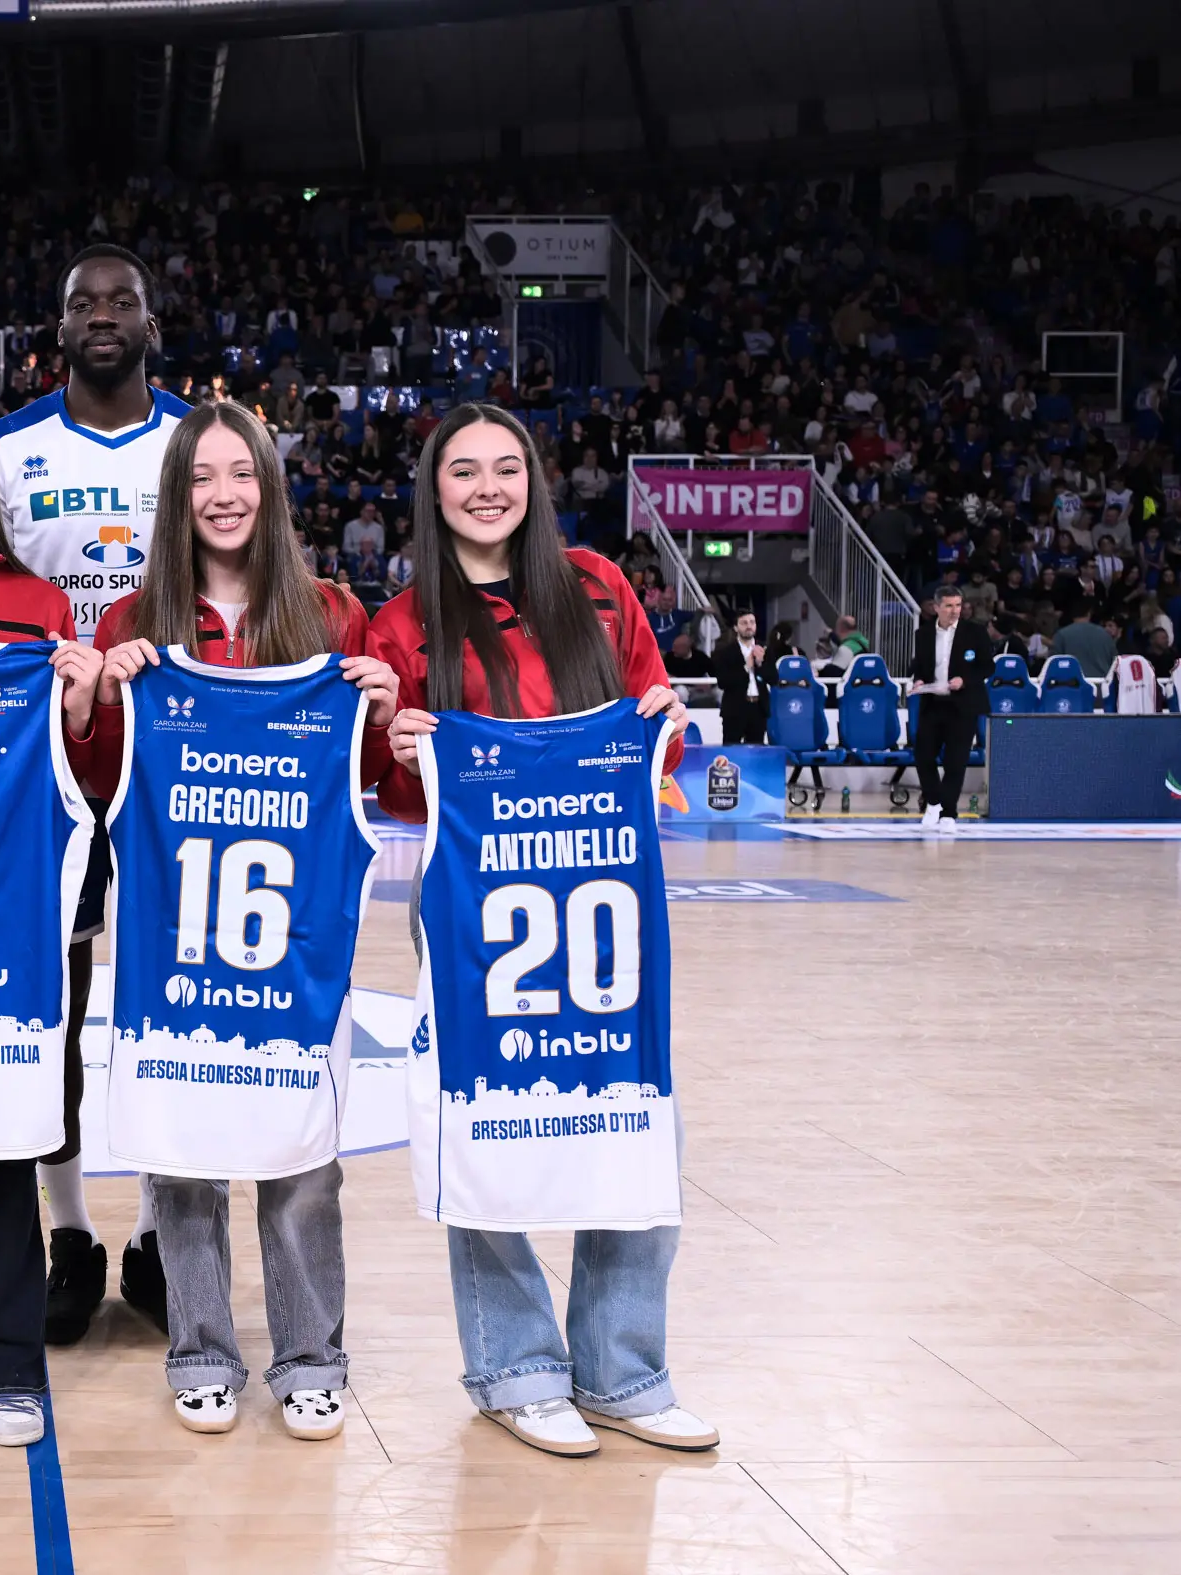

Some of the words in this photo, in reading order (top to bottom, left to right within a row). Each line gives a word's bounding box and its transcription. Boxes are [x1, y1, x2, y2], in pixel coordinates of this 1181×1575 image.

[527, 238, 596, 252] OTIUM
[62, 486, 130, 512] BTL
[665, 483, 805, 517] INTRED
[153, 719, 190, 727] CAROLINA
[190, 721, 207, 729] ZANI
[267, 722, 331, 733] BERNARDELLI
[180, 743, 307, 779] bonera.
[459, 769, 498, 778] CAROLINA
[498, 768, 515, 776] ZANI
[577, 755, 642, 767] BERNARDELLI
[711, 778, 736, 788] LBA
[169, 783, 309, 829] GREGORIO
[492, 791, 623, 821] bonera.
[479, 825, 637, 873] ANTONELLO
[175, 837, 295, 971] 16
[481, 878, 642, 1017] 20
[203, 978, 293, 1010] inblu
[539, 1029, 632, 1057] inblu
[136, 1059, 188, 1082] BRESCIA
[190, 1063, 262, 1086] LEONESSA
[265, 1067, 320, 1090] D'ITALIA
[471, 1118, 532, 1141] BRESCIA
[535, 1113, 606, 1138] LEONESSA
